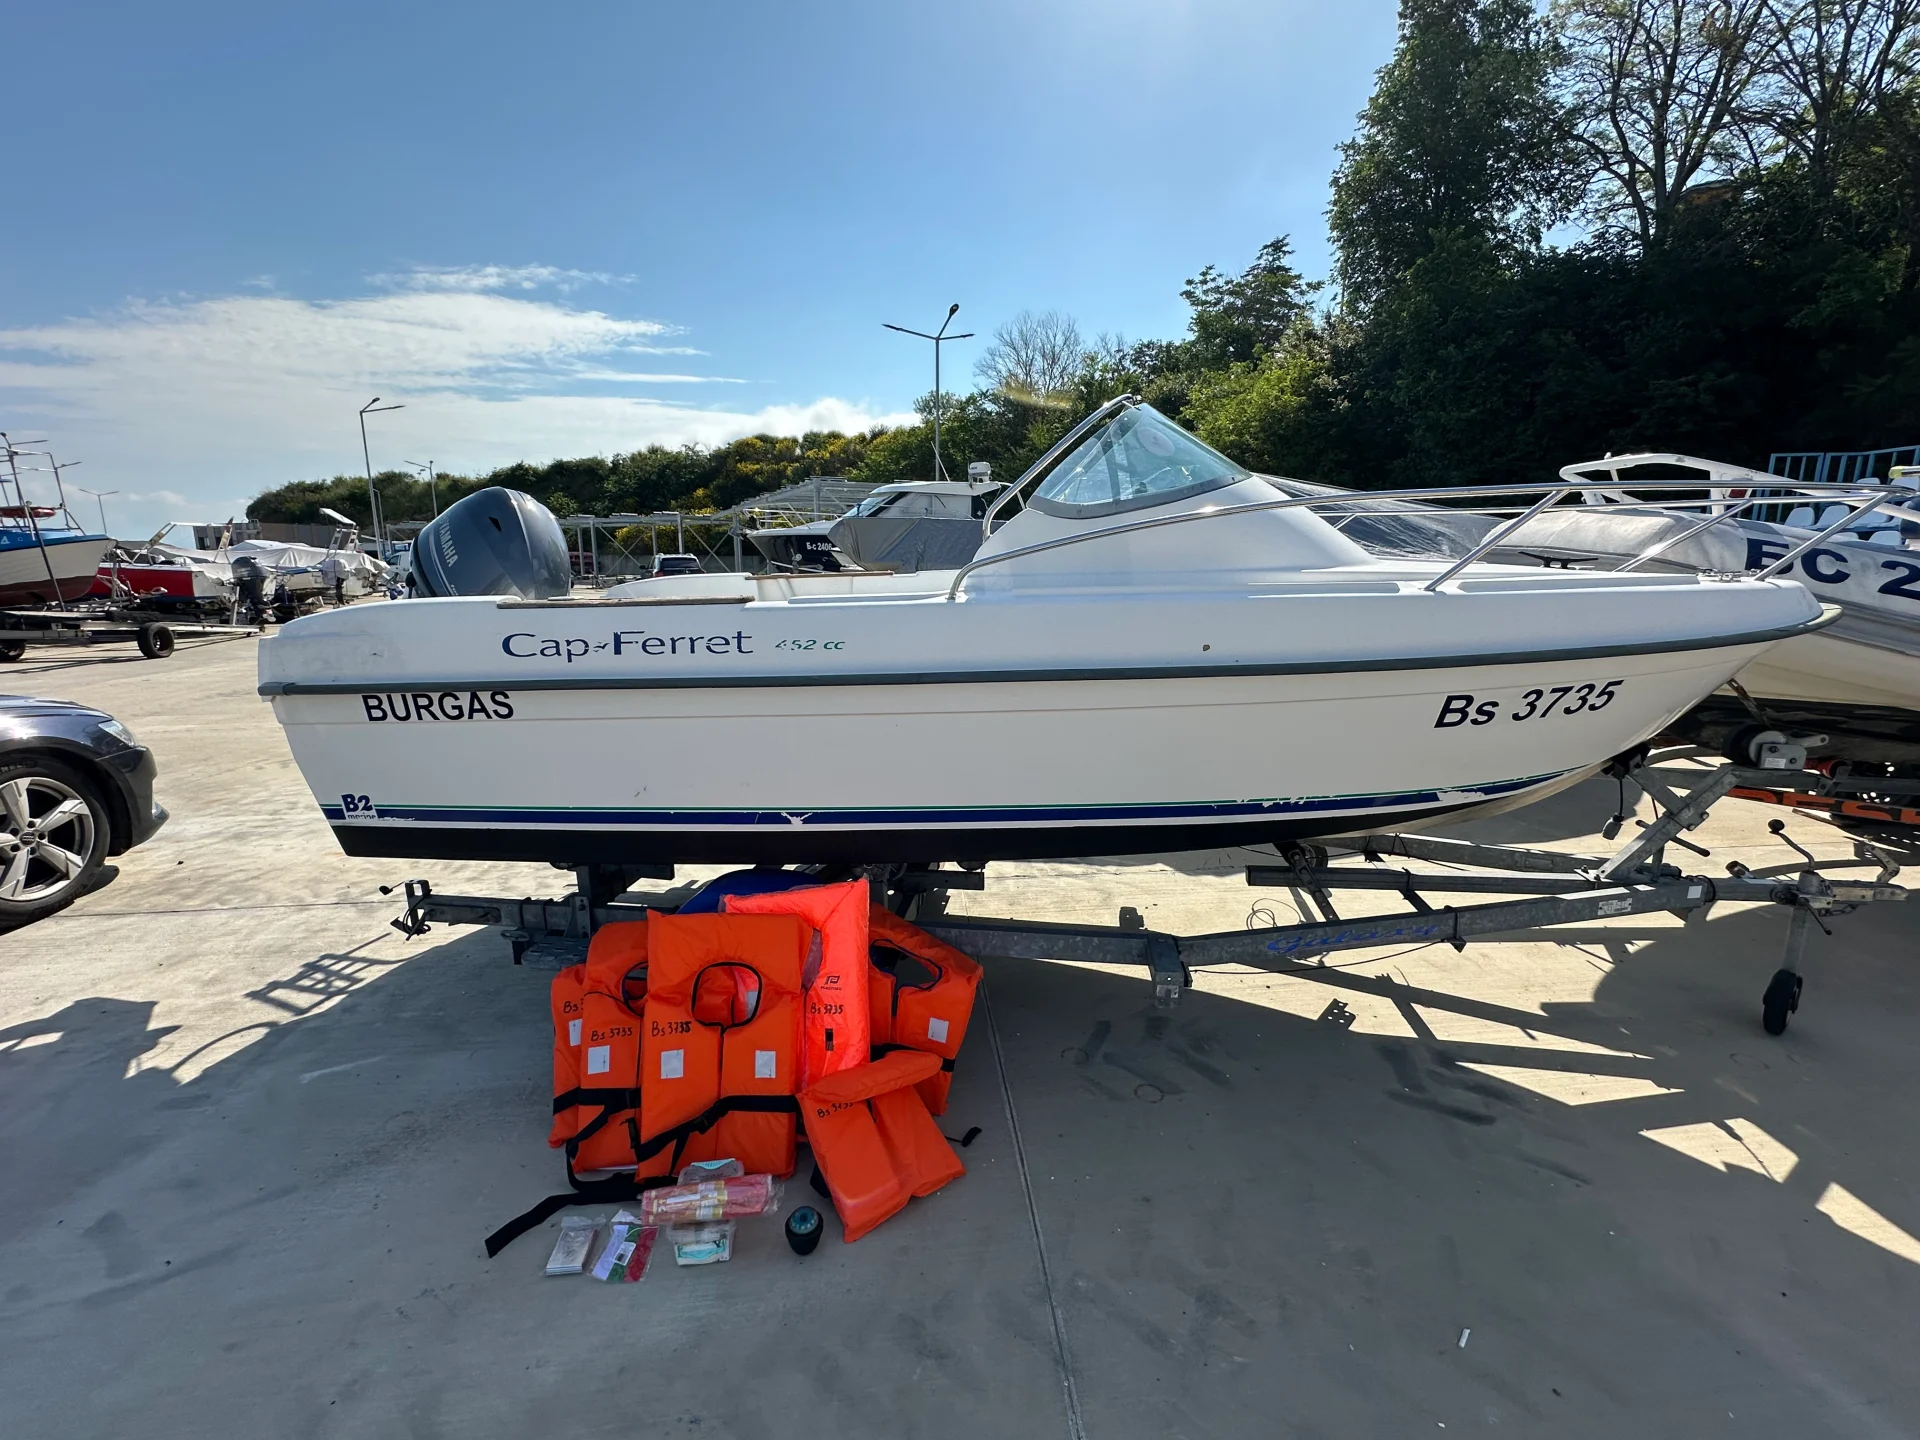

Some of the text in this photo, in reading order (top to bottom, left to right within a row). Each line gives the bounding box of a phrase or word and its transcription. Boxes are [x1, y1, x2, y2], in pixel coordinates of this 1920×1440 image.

[438, 521, 459, 568] YAMAHA
[361, 691, 514, 722] BURGAS
[1433, 679, 1625, 729] Bs 3735
[341, 793, 373, 813] B2
[563, 1000, 579, 1013] Bs
[811, 1002, 844, 1015] Bs 3735
[590, 1026, 633, 1041] Bs 3735
[651, 1020, 666, 1037] Bs
[816, 1108, 831, 1118] Bs
